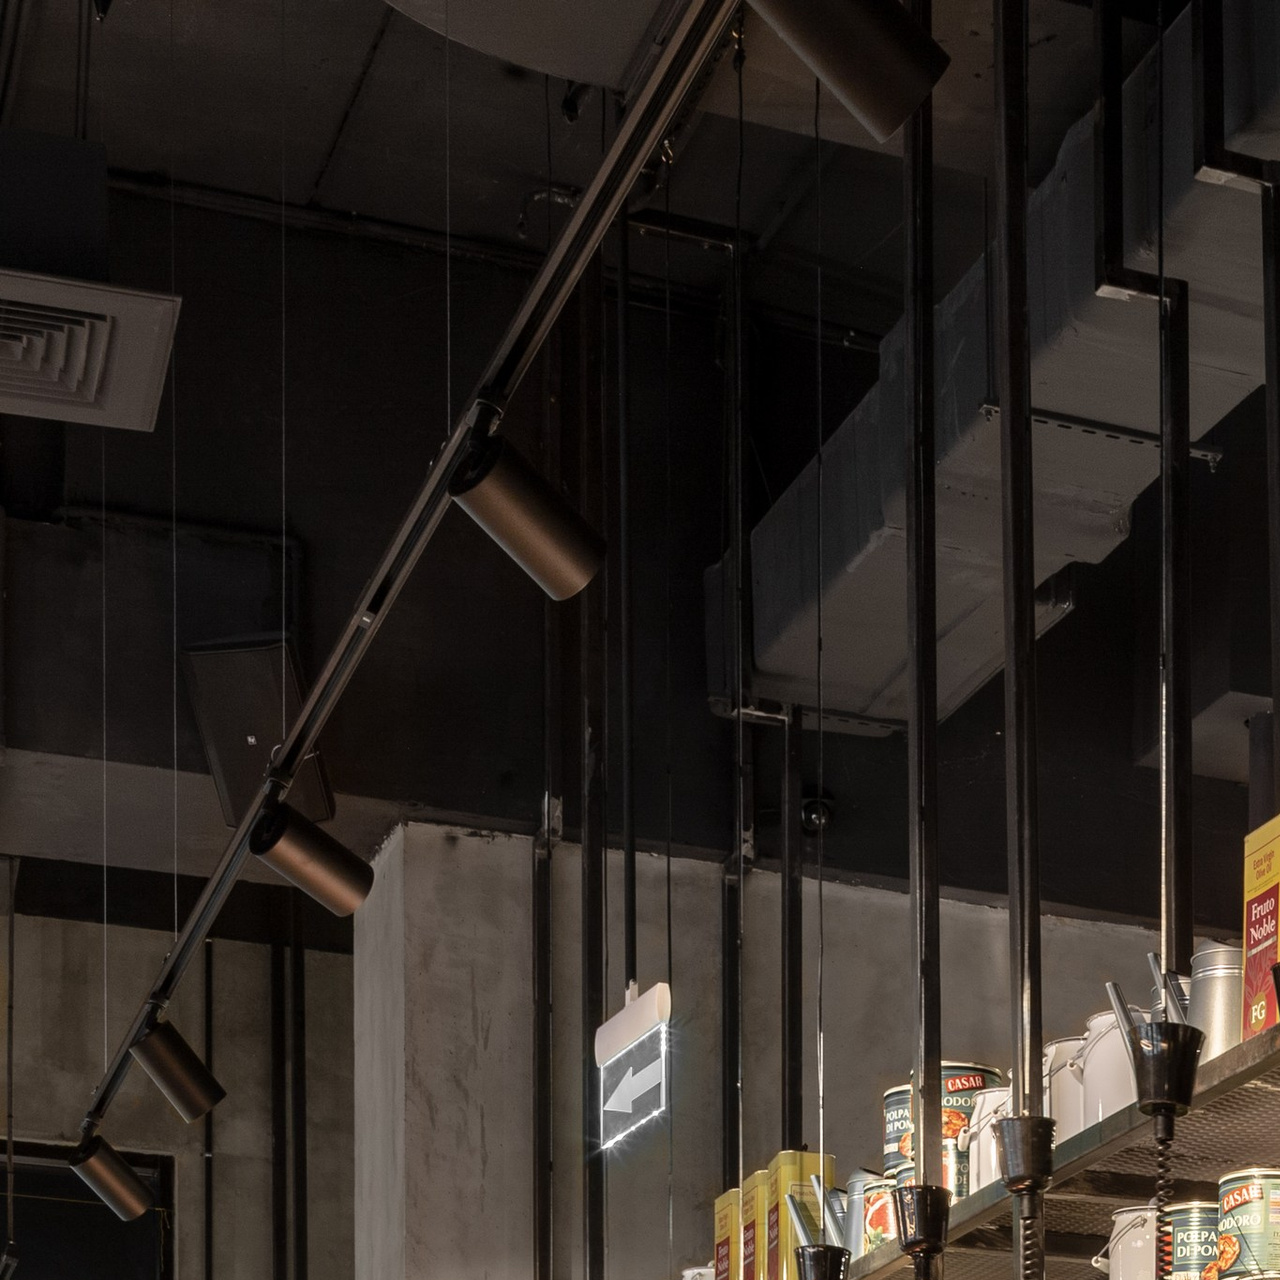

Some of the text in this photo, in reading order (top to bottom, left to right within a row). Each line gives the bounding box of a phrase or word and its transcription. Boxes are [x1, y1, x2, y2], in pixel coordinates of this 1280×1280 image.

[1253, 850, 1275, 870] Extra Virgin
[1256, 868, 1266, 881] Olive
[1251, 897, 1274, 922] Fruto
[1250, 917, 1276, 944] Noble
[1251, 1001, 1266, 1024] FG
[886, 1108, 910, 1122] POLPA
[886, 1123, 893, 1133] DI
[1218, 1214, 1261, 1232] ODORO
[1177, 1231, 1218, 1244] POLPA
[1177, 1247, 1190, 1258] DI
